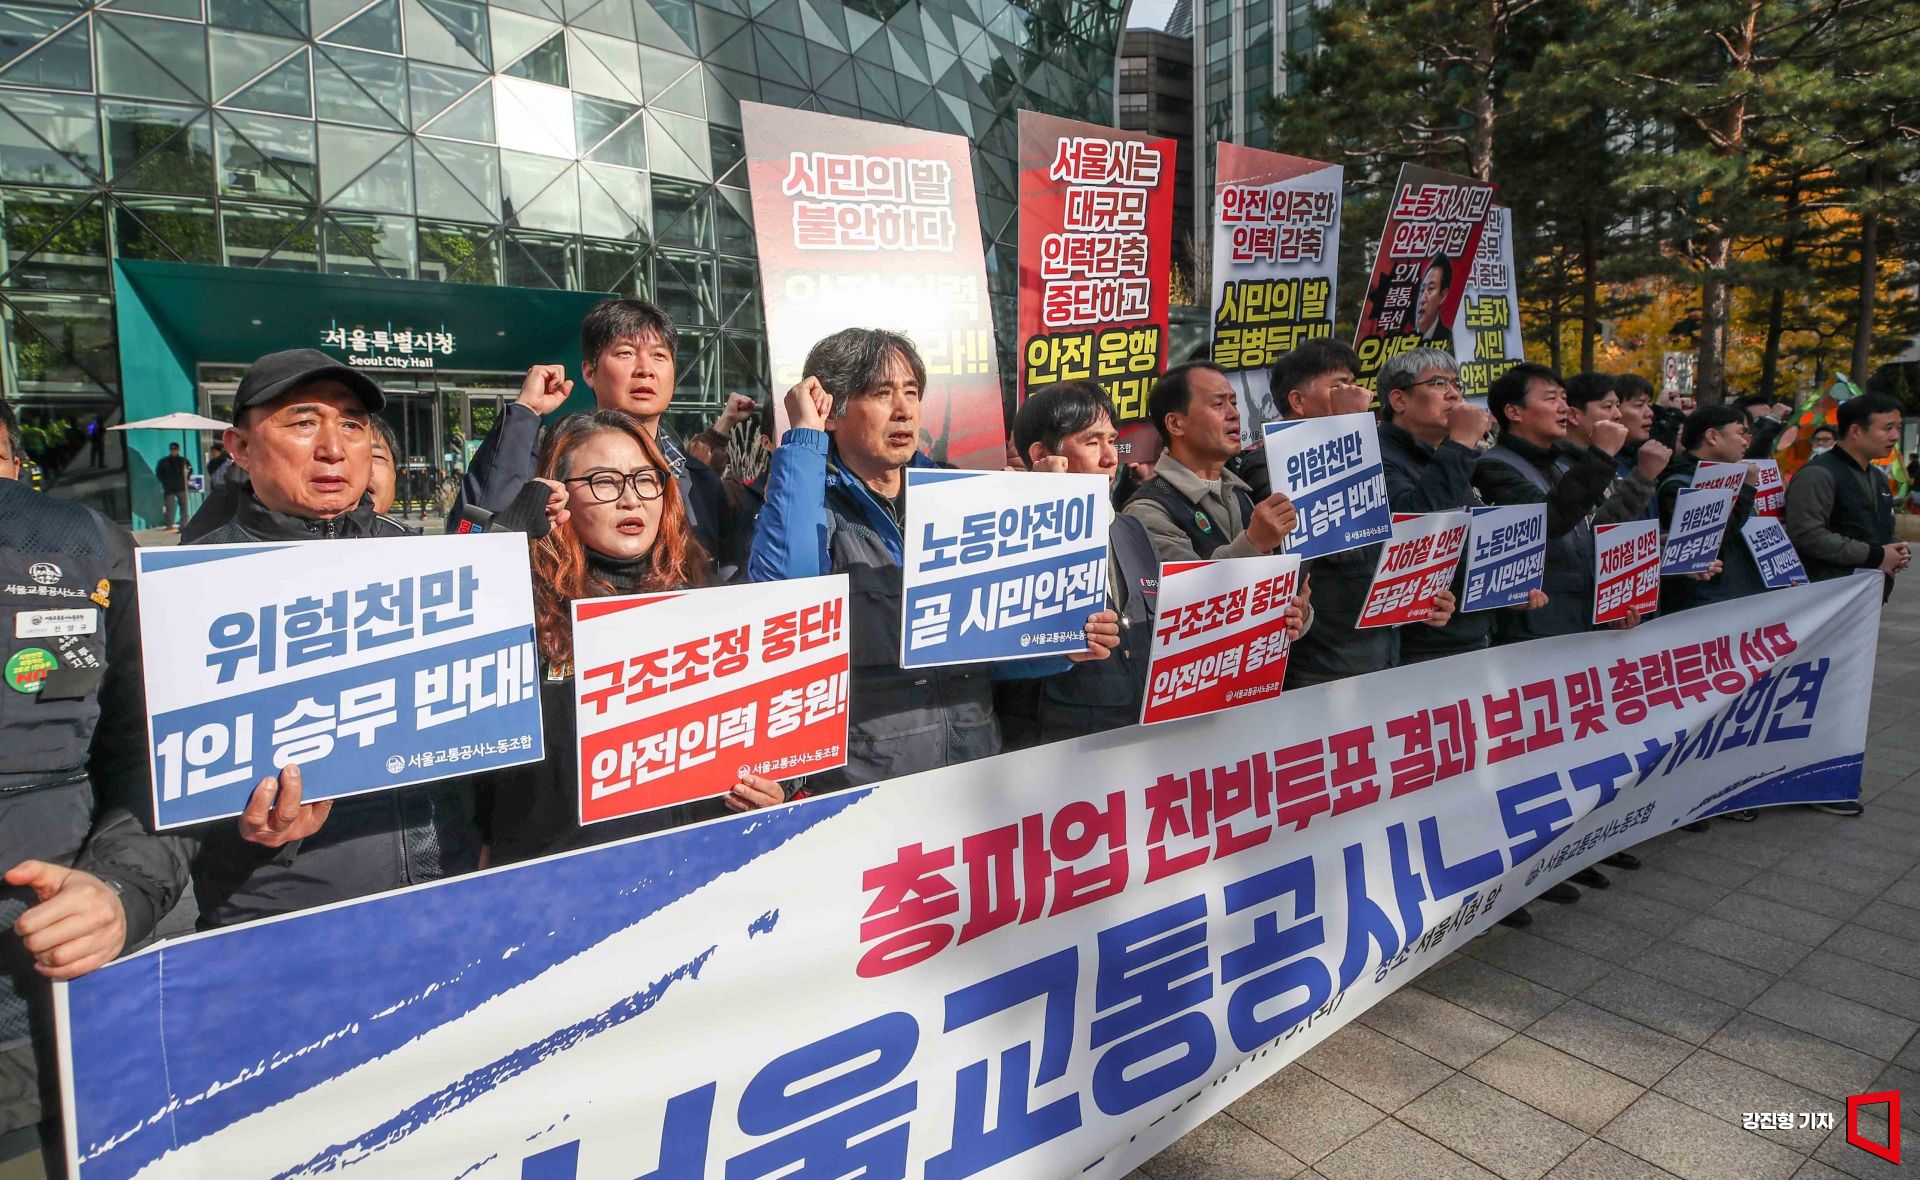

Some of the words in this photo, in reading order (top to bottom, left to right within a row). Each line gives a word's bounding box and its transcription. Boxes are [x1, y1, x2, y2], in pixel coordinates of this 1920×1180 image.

[783, 153, 905, 200] 시민의
[909, 161, 950, 204] 발
[1052, 138, 1160, 185] 서울시는
[795, 203, 956, 250] 불안하다
[1065, 187, 1147, 231] 대규모
[1222, 187, 1267, 224] 안전
[1270, 190, 1335, 225] 외주화
[1042, 235, 1149, 278] 인력감축
[1232, 226, 1275, 262] 인력
[1279, 228, 1323, 261] 감축
[1384, 287, 1412, 308] 불통,
[1391, 264, 1420, 284] 오기,
[1044, 279, 1150, 325] 중단하고
[1218, 284, 1297, 323] 시민의
[1301, 281, 1328, 319] 발
[1378, 310, 1405, 331] 독선
[1465, 297, 1508, 328] 노동자
[326, 328, 454, 354] 서울특별시청
[349, 355, 382, 366] Seoul
[385, 356, 408, 368] City
[410, 357, 433, 367] Hall
[1028, 335, 1090, 384] 안전
[1098, 330, 1157, 375] 운행
[1475, 330, 1504, 359] 시민
[1461, 363, 1488, 395] 안전
[1287, 431, 1362, 492] 위험천만
[1310, 491, 1346, 538] 승무
[1348, 474, 1386, 519] 반대!
[1680, 500, 1724, 533] 위험천만
[919, 494, 1095, 573] 노동안전이
[1380, 535, 1434, 574] 지하철
[1433, 524, 1466, 560] 안전
[1474, 514, 1542, 562] 노동안전이
[1600, 542, 1634, 576] 지하철
[1638, 528, 1657, 559] 안전
[4, 584, 88, 598] 서울교통공사노조
[1365, 579, 1422, 618] 공공성
[1467, 574, 1485, 604] 곧
[1486, 550, 1544, 596] 시민안전!
[1597, 580, 1633, 615] 공공성
[206, 565, 479, 684] 위험천만
[910, 593, 952, 651] 곧
[959, 557, 1107, 637] 시민안전!
[1156, 586, 1248, 646] 구조조정
[1250, 571, 1296, 616] 중단!
[581, 624, 751, 715] 구조조정
[761, 597, 843, 663] 중단!
[1150, 644, 1243, 708] 안전인력
[1246, 629, 1290, 673] 충원!
[156, 713, 254, 802] 1인
[272, 677, 398, 769] 승무
[414, 642, 536, 731] 반대!
[591, 701, 757, 800] 안전인력
[767, 670, 848, 739] 충원!
[407, 735, 532, 769] 서울교통공사노동조합
[752, 745, 840, 775] 서울교통공사노동조합
[856, 791, 1130, 978] 총파업
[1143, 725, 1381, 885] 찬반투표
[1386, 698, 1479, 800] 결과
[1482, 679, 1565, 765] 보고
[1564, 666, 1610, 741] 및
[1607, 634, 1746, 726] 총력투쟁
[1544, 801, 1656, 873] 서울교통공사노동조합
[1415, 895, 1484, 953] 서울시청
[1481, 884, 1503, 915] 앞
